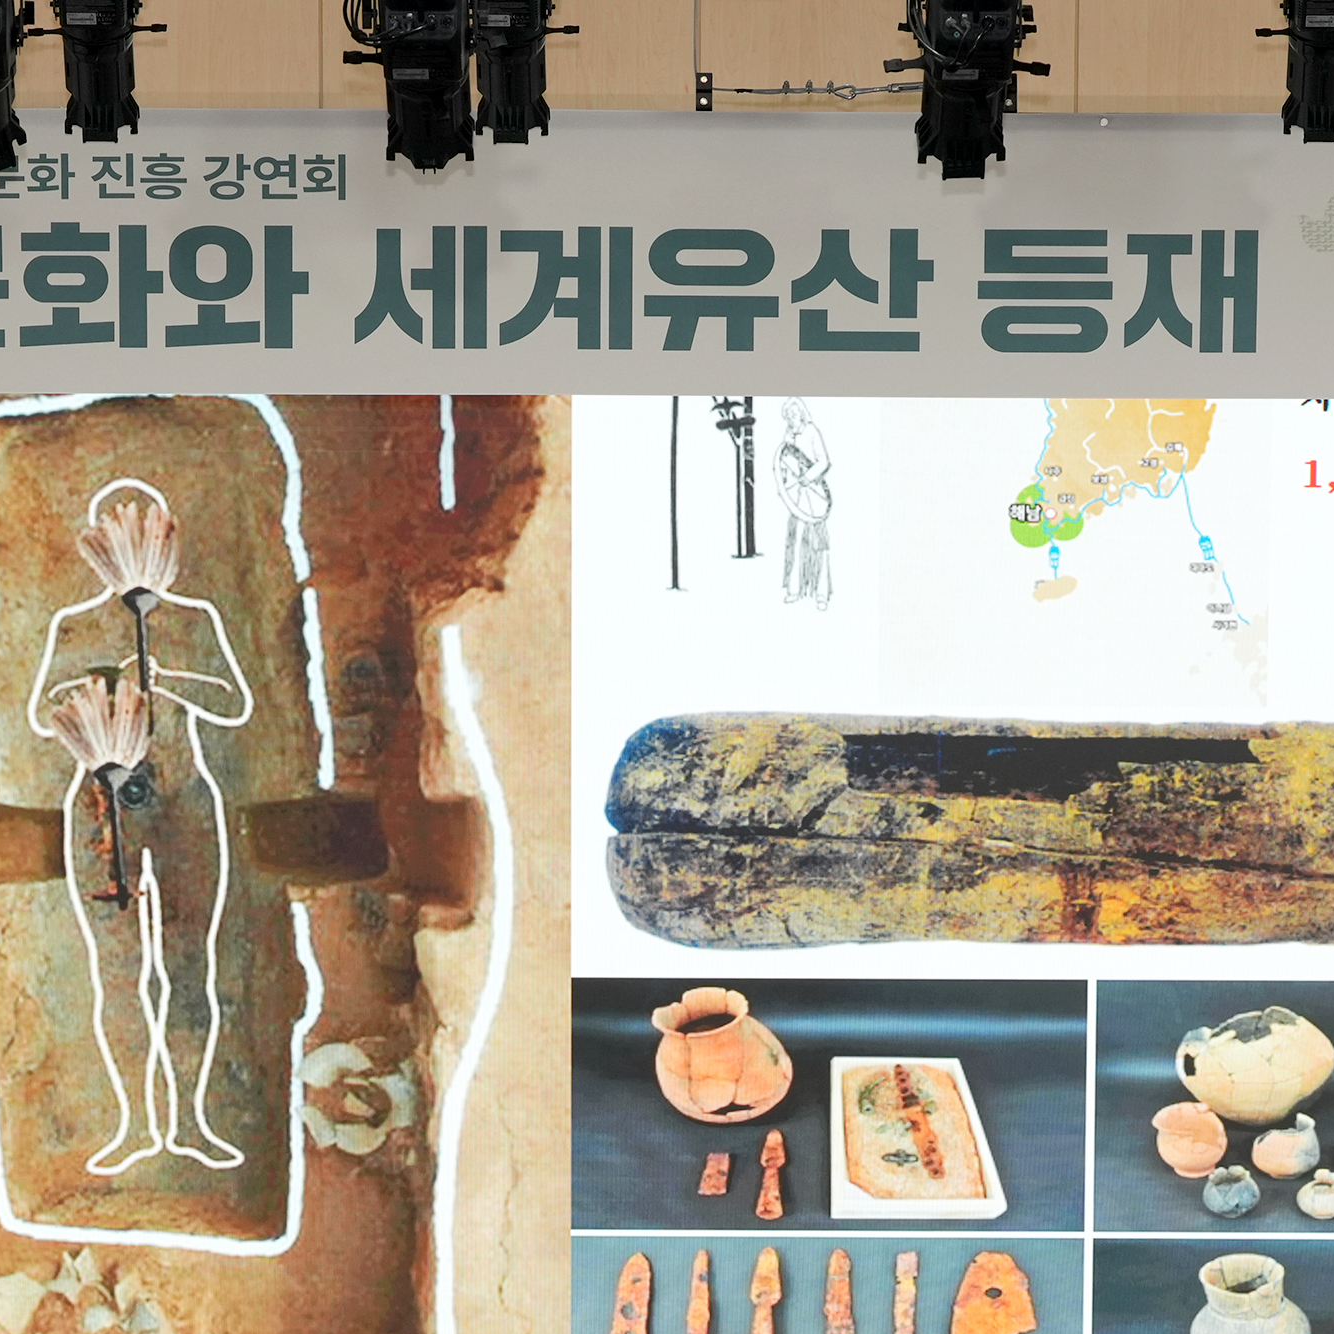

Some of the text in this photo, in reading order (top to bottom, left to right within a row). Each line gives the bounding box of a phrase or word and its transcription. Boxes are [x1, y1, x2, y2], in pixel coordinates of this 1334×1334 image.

[91, 153, 187, 199] 진흥
[203, 154, 346, 200] 강연회
[355, 226, 934, 351] 세계유산
[978, 229, 1258, 353] 등재
